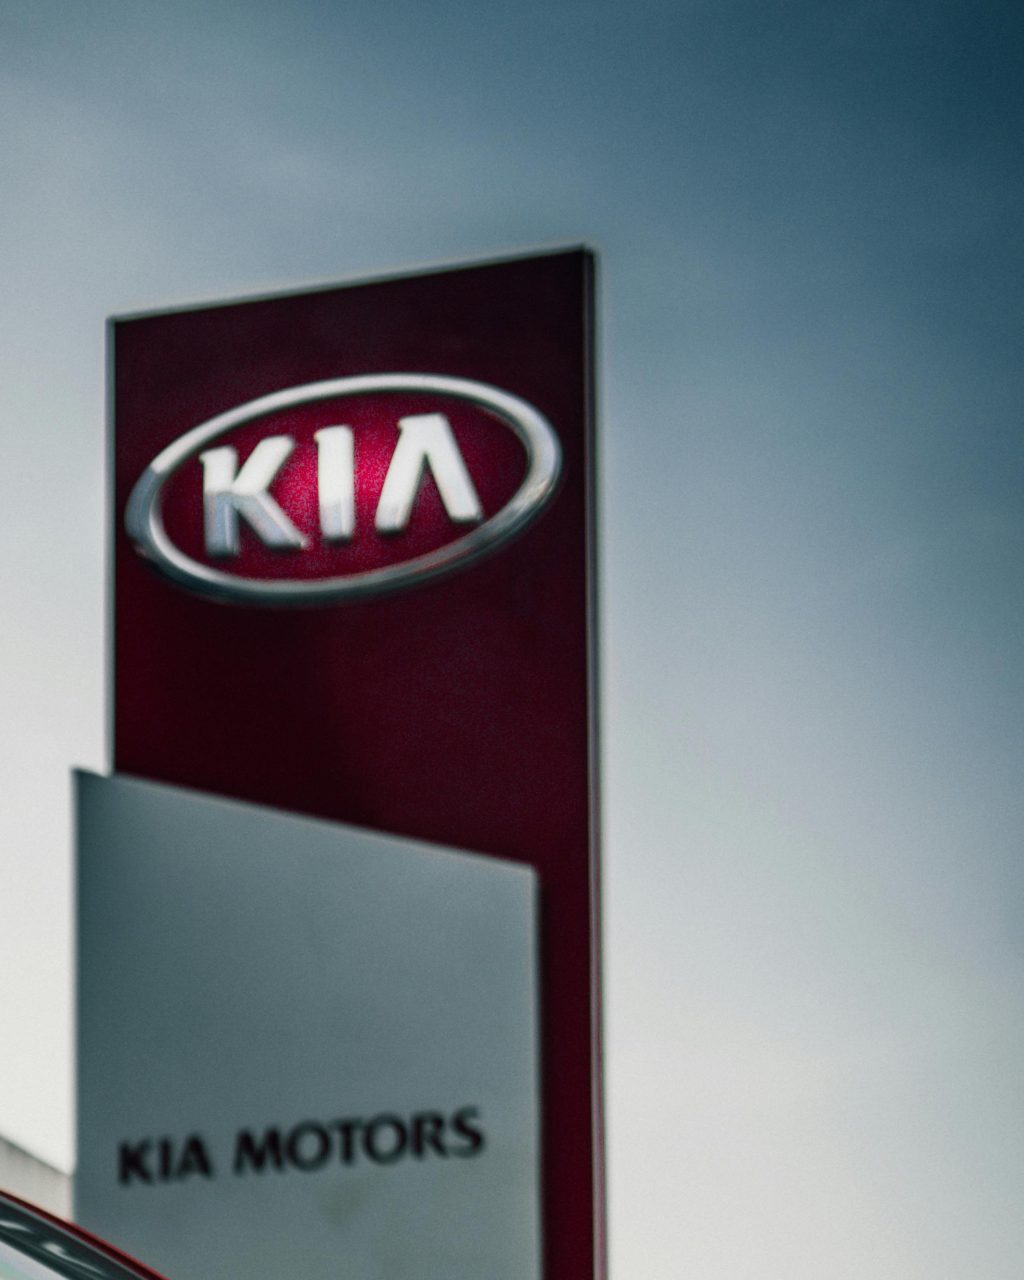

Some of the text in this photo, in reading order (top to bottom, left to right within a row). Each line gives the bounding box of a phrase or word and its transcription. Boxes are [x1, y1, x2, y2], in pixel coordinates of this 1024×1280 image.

[199, 412, 483, 556] KIA
[117, 1105, 486, 1187] KIA MOTORS
